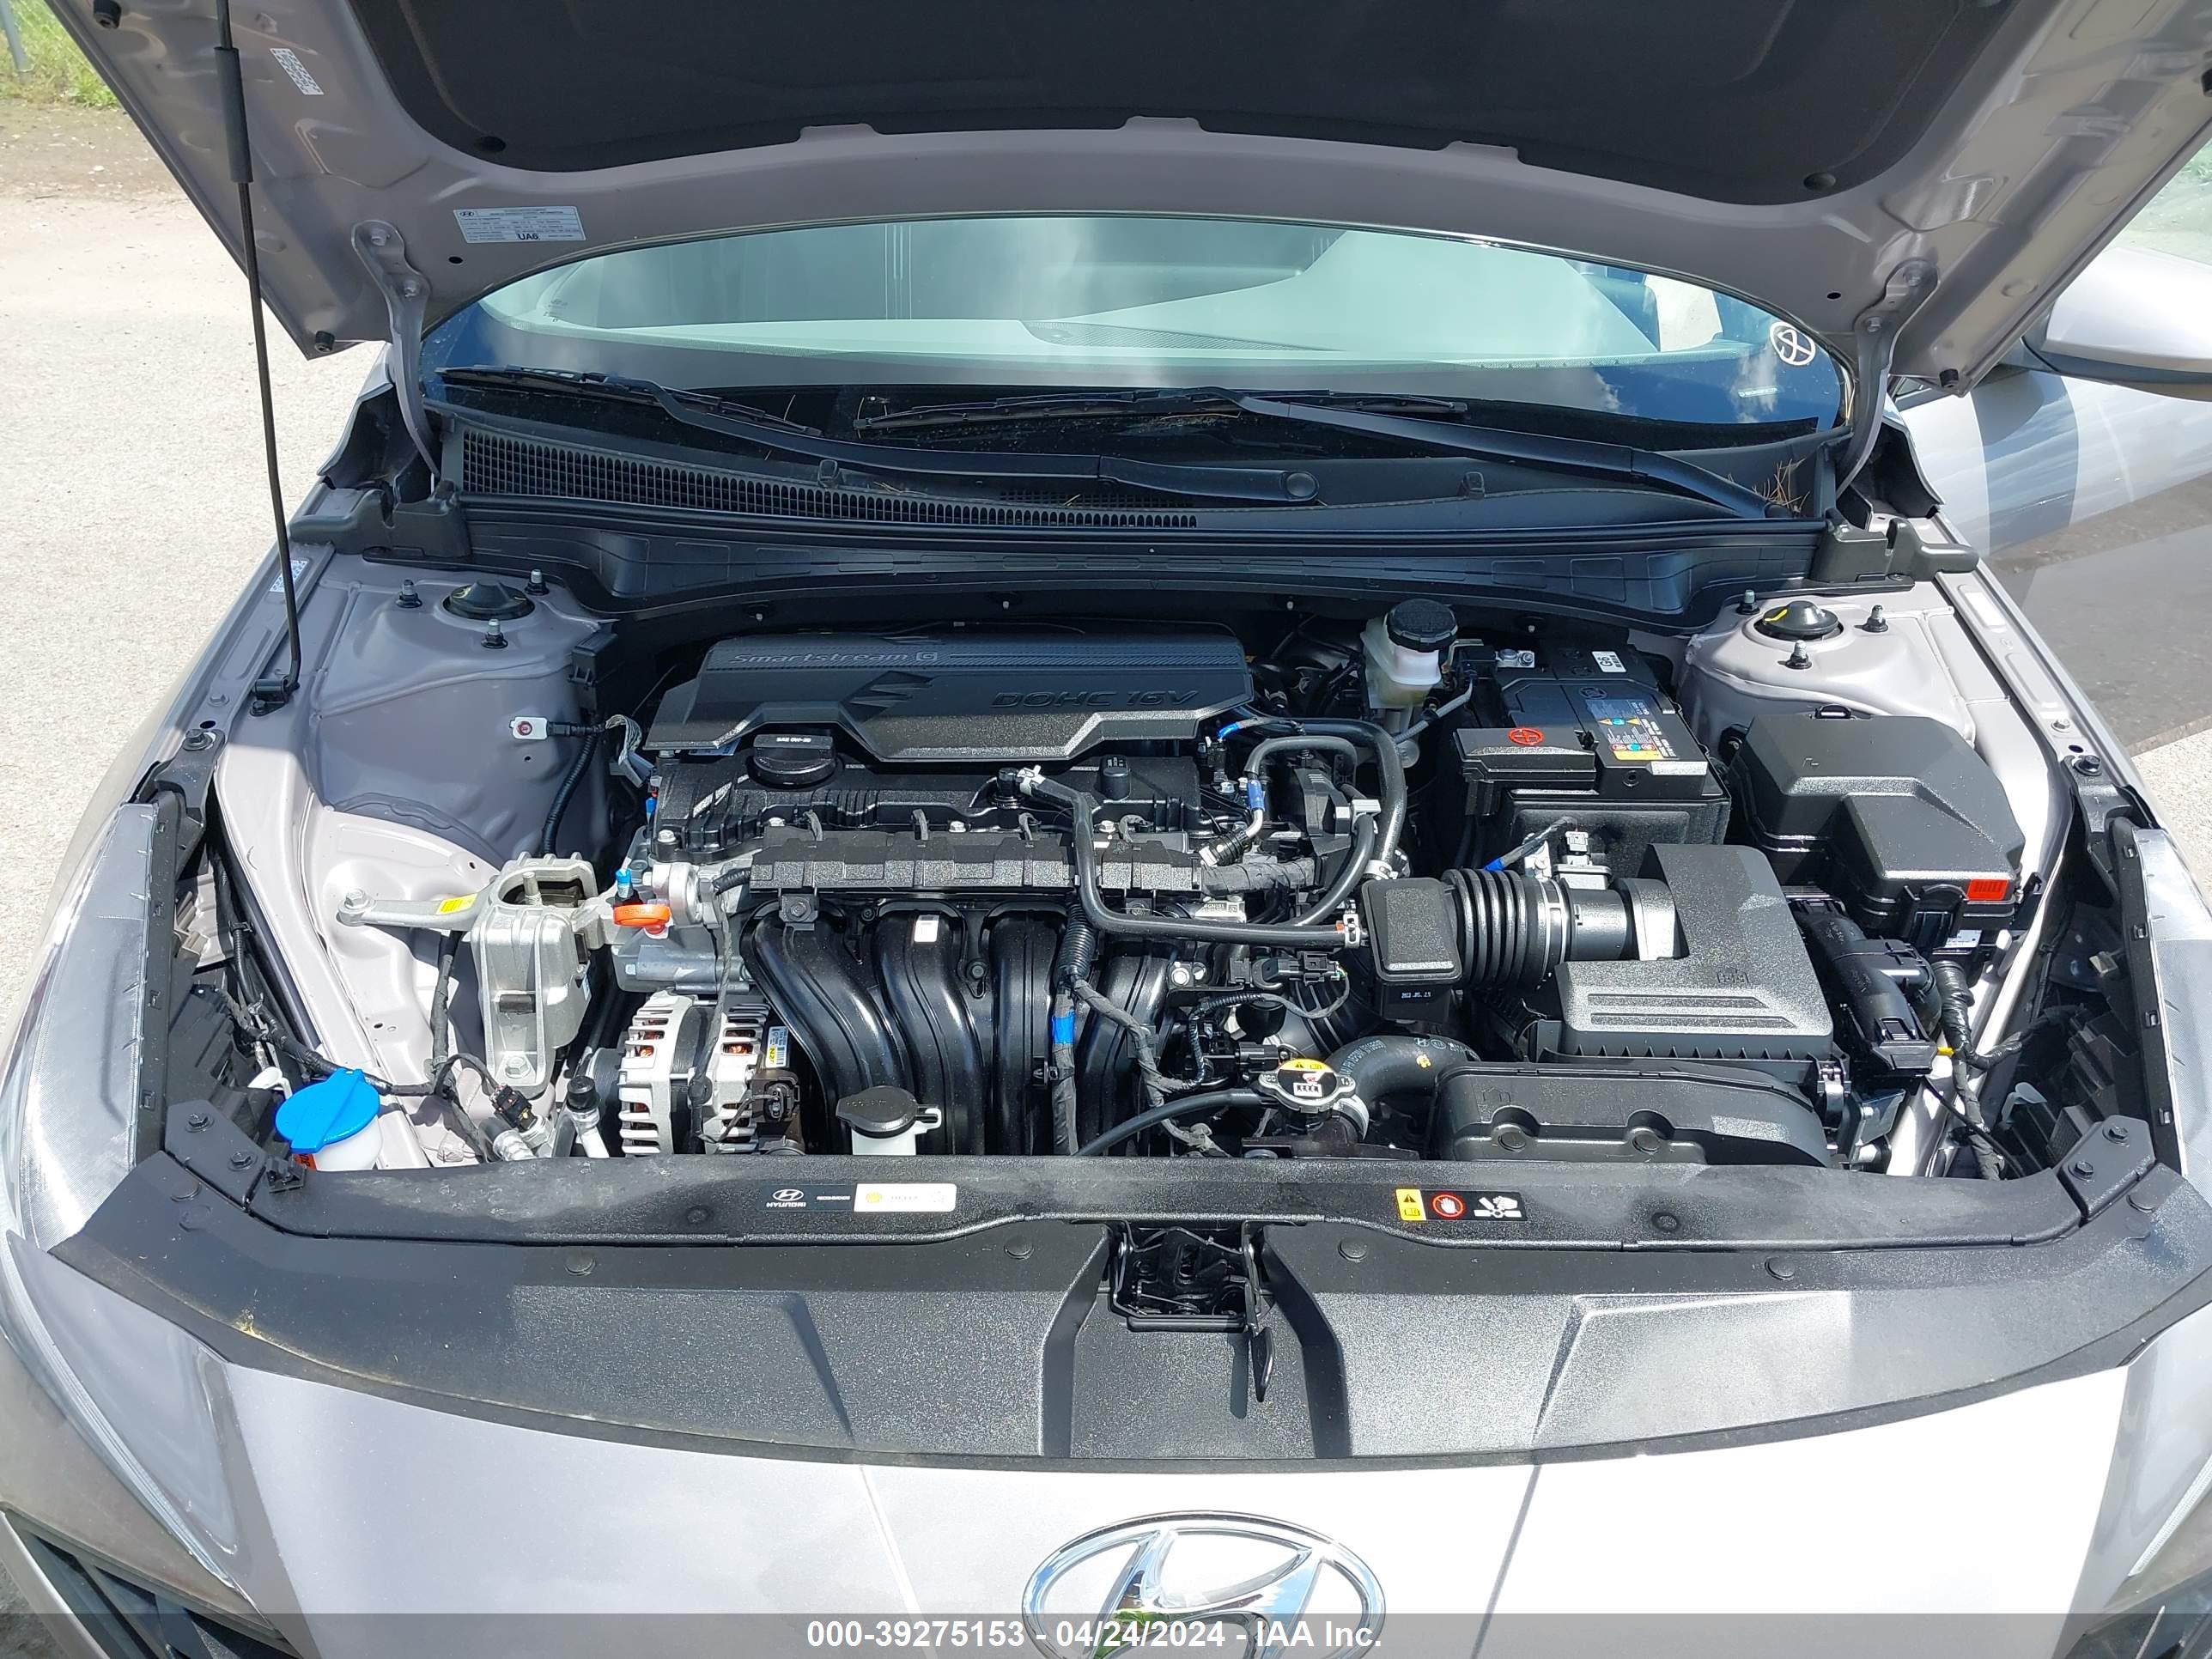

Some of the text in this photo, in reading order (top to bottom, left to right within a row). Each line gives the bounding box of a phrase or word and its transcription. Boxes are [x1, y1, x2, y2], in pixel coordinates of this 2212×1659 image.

[730, 652, 908, 664] Smartstream
[1597, 656, 1613, 667] G6
[989, 690, 1200, 708] DOHC 16V
